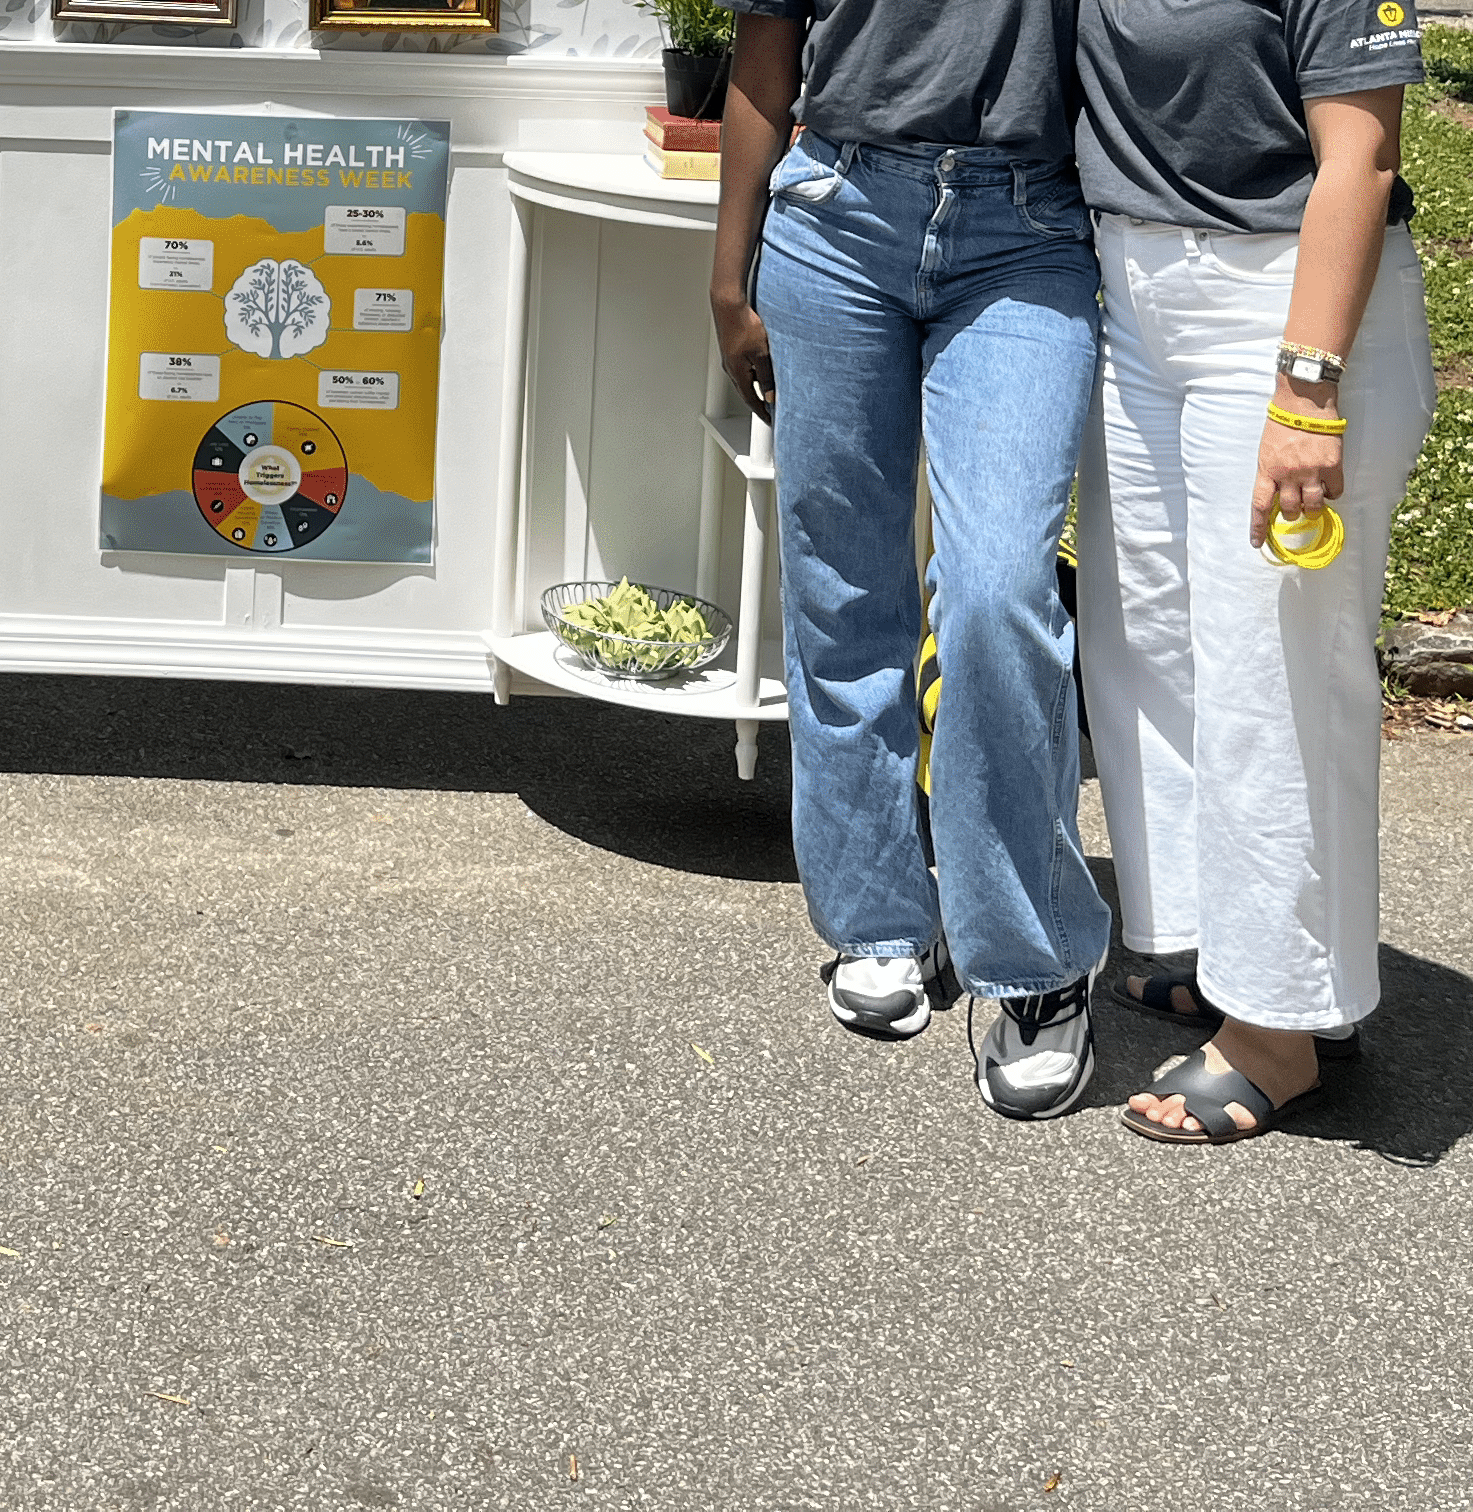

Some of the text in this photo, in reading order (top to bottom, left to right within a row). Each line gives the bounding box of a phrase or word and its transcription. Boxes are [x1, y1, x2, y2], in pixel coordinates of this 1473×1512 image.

[1350, 31, 1398, 49] ATLANTA
[147, 136, 405, 168] MENTAL HEALTH
[168, 163, 413, 189] AWARENESS WEEK
[346, 209, 385, 219] 25-30%
[164, 240, 189, 250] 70%
[375, 292, 397, 302] 71%
[168, 356, 192, 367] 38%
[332, 375, 385, 386] 50% 60%
